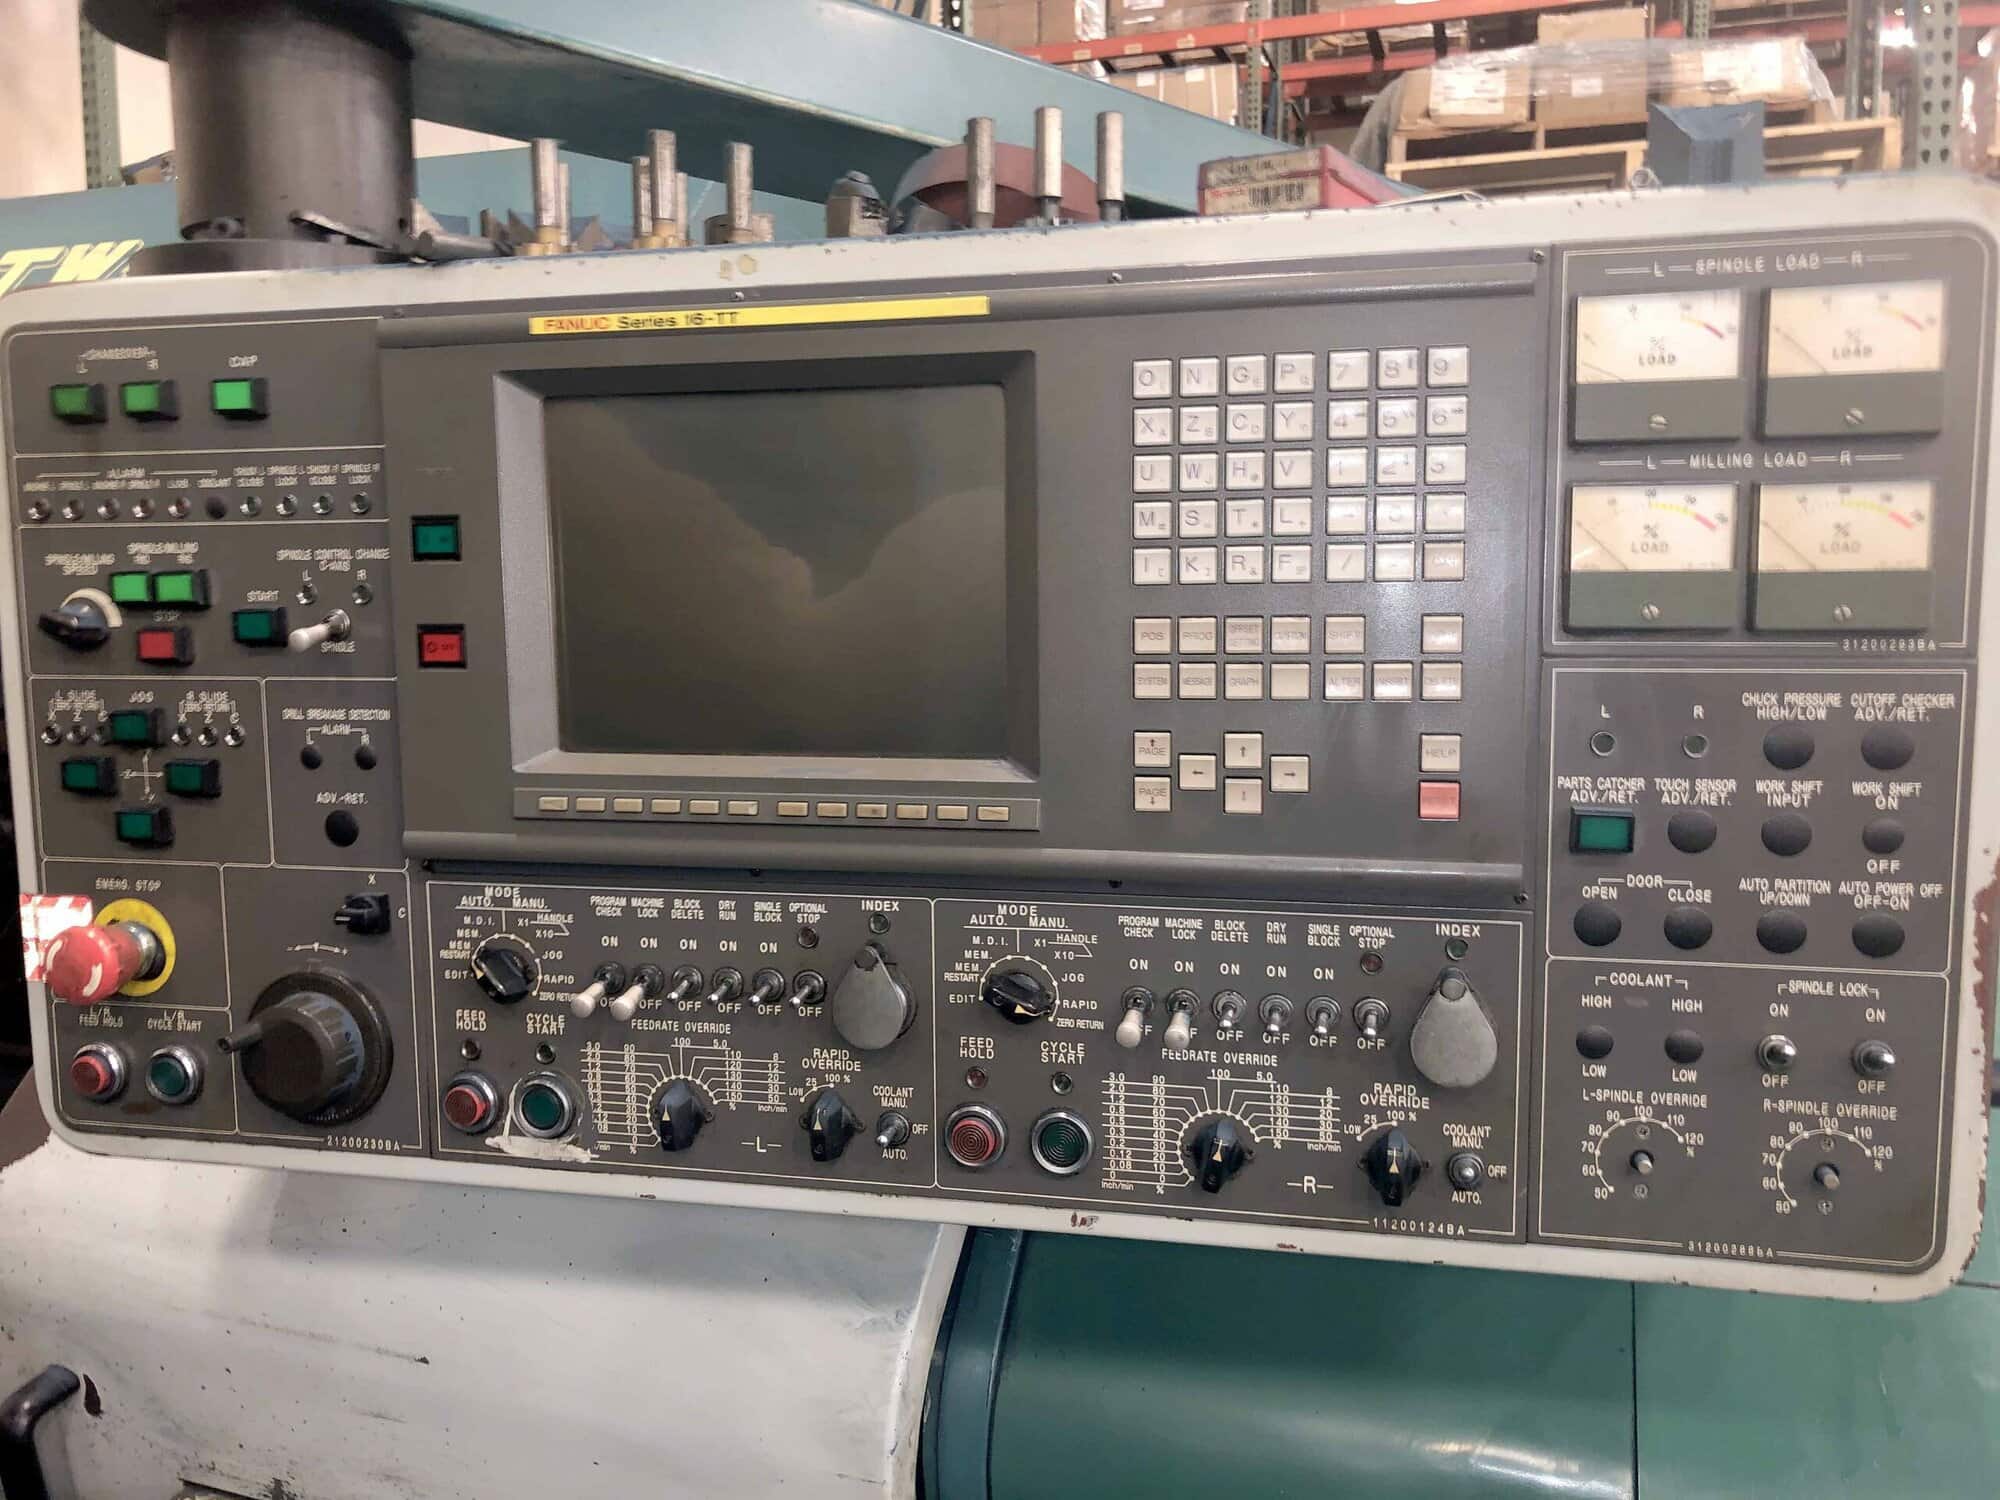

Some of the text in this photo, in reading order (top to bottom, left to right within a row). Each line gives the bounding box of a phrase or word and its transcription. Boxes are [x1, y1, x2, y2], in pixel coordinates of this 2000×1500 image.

[1696, 255, 1820, 275] SPINDLE LOAD
[544, 312, 739, 331] FANUC Series 16-TT
[1832, 346, 1872, 360] LOAD
[1639, 353, 1677, 366] LOAD
[1233, 366, 1249, 383] G
[1690, 452, 1807, 468] MILLING LOAD
[1186, 510, 1199, 526] S
[1631, 542, 1669, 553] LOAD
[1820, 541, 1860, 553] LOAD
[276, 548, 390, 560] SPINDLE CONTROL CHANGE
[1141, 632, 1165, 640] POS
[1742, 692, 1843, 707] CHUCK PRESSURE
[1851, 693, 1955, 709] CUTOFF CHECKER
[349, 709, 390, 720] DETECTION
[1601, 704, 1610, 718] L
[1693, 705, 1704, 719] R
[1757, 706, 1827, 720] HIGH/LOW
[1855, 707, 1931, 721] ADV./RET.
[1558, 776, 1645, 791] PARTS CATCHER
[1654, 778, 1736, 793] TOUCH SENSOR
[1756, 780, 1824, 794] WORK SHIFT
[1852, 781, 1922, 797] WORK SHIFT
[1570, 791, 1639, 803] ADV./RET.
[1661, 793, 1732, 806] ADV./RET.
[1767, 793, 1812, 808] INPUT
[1875, 796, 1898, 810] ON
[1867, 859, 1900, 874] OFF
[136, 879, 161, 891] STOP
[1627, 874, 1663, 888] DOOR
[1739, 878, 1831, 894] AUTO PARTITION
[485, 886, 520, 898] MODE
[1582, 886, 1618, 900] OPEN
[1668, 888, 1712, 903] CLOSE
[1839, 881, 1944, 898] AUTO POWER OFF
[461, 896, 548, 909] AUTO. MANU.
[591, 896, 626, 907] PROGRAM
[631, 897, 664, 908] MACHINE
[674, 899, 701, 909] BLOCK
[719, 900, 736, 910] DRY
[1760, 892, 1810, 906] UP/DOWN
[1854, 895, 1910, 911] OFF-ON
[596, 907, 622, 917] CHECK
[754, 902, 781, 911] SINGLE
[789, 903, 828, 913] OPTIONAL
[862, 900, 900, 912] INDEX
[998, 905, 1038, 916] MODE
[537, 914, 574, 923] HANDLE
[638, 908, 658, 918] LOCK
[671, 909, 704, 920] DELETE
[719, 911, 736, 920] RUN
[754, 912, 782, 922] BLOCK
[797, 914, 821, 923] STOP
[970, 915, 1068, 928] AUTO. MANU.
[1118, 916, 1159, 927] PROGRAM
[1165, 918, 1203, 929] MACHINE
[1215, 920, 1245, 930] BLOCK
[1267, 922, 1287, 932] DRY
[1124, 928, 1154, 938] CHECK
[1172, 930, 1196, 940] LOCK
[1308, 924, 1340, 935] SINGLE
[1350, 926, 1395, 938] OPTIONAL
[1436, 924, 1480, 937] INDEX
[1057, 934, 1098, 944] HANDLE
[1211, 931, 1248, 942] DELETE
[1267, 934, 1287, 944] RUN
[1308, 937, 1340, 947] BLOCK
[1359, 938, 1386, 948] STOP
[542, 951, 563, 960] JOG
[965, 951, 992, 959] MEM.
[955, 963, 983, 971] MEM.
[1130, 959, 1148, 970] ON
[1175, 961, 1194, 972] ON
[1220, 964, 1240, 975] ON
[445, 970, 467, 979] EDIT
[944, 973, 979, 982] RESTART
[1267, 966, 1287, 977] ON
[1314, 968, 1334, 980] ON
[544, 975, 574, 984] RAPID
[1062, 974, 1085, 982] JOG
[1610, 973, 1672, 987] COOLANT
[1789, 980, 1869, 997] SPINDLE LOCK
[950, 995, 975, 1003] EDIT
[1063, 1000, 1097, 1009] RAPID
[1582, 995, 1611, 1008] HIGH
[1672, 999, 1703, 1013] HIGH
[1770, 1003, 1789, 1017] ON
[456, 1009, 486, 1020] FEED
[526, 1013, 565, 1025] CYCLE
[1866, 1008, 1885, 1022] ON
[456, 1021, 486, 1031] HOLD
[527, 1024, 565, 1035] START
[632, 1020, 731, 1035] FEEDRATE OVERRIDE
[1057, 1018, 1104, 1029] ZERO RETURN
[960, 1037, 993, 1048] FEED
[1041, 1041, 1085, 1053] CYCLE
[813, 1048, 849, 1060] RAPID
[960, 1049, 994, 1059] HOLD
[1041, 1052, 1085, 1064] START
[1162, 1049, 1278, 1066] FEEDRATE OVERRIDE
[802, 1059, 861, 1071] OVERRIDE
[1582, 1064, 1607, 1078] LOW
[1672, 1069, 1697, 1083] LOW
[1762, 1075, 1789, 1088] OFF
[873, 1086, 914, 1098] COOLANT
[1374, 1083, 1416, 1096] RAPID
[1858, 1080, 1887, 1094] OFF
[881, 1097, 908, 1108] MANU.
[1360, 1094, 1430, 1109] OVERRIDE
[1583, 1089, 1707, 1108] L-SPINDLE OVERRIDE
[1635, 1106, 1652, 1117] 100
[1764, 1099, 1897, 1121] R-SPINDLE OVERRIDE
[1668, 1114, 1684, 1126] 110
[913, 1125, 928, 1134] OFF
[1443, 1124, 1491, 1137] COOLANT
[1452, 1136, 1484, 1149] MANU.
[1685, 1133, 1703, 1145] 120
[883, 1149, 908, 1160] AUTO.
[1488, 1165, 1507, 1178] OFF
[1304, 1176, 1316, 1194] R
[1451, 1191, 1481, 1205] AUTO.
[1374, 1218, 1465, 1235] 11200124BA
